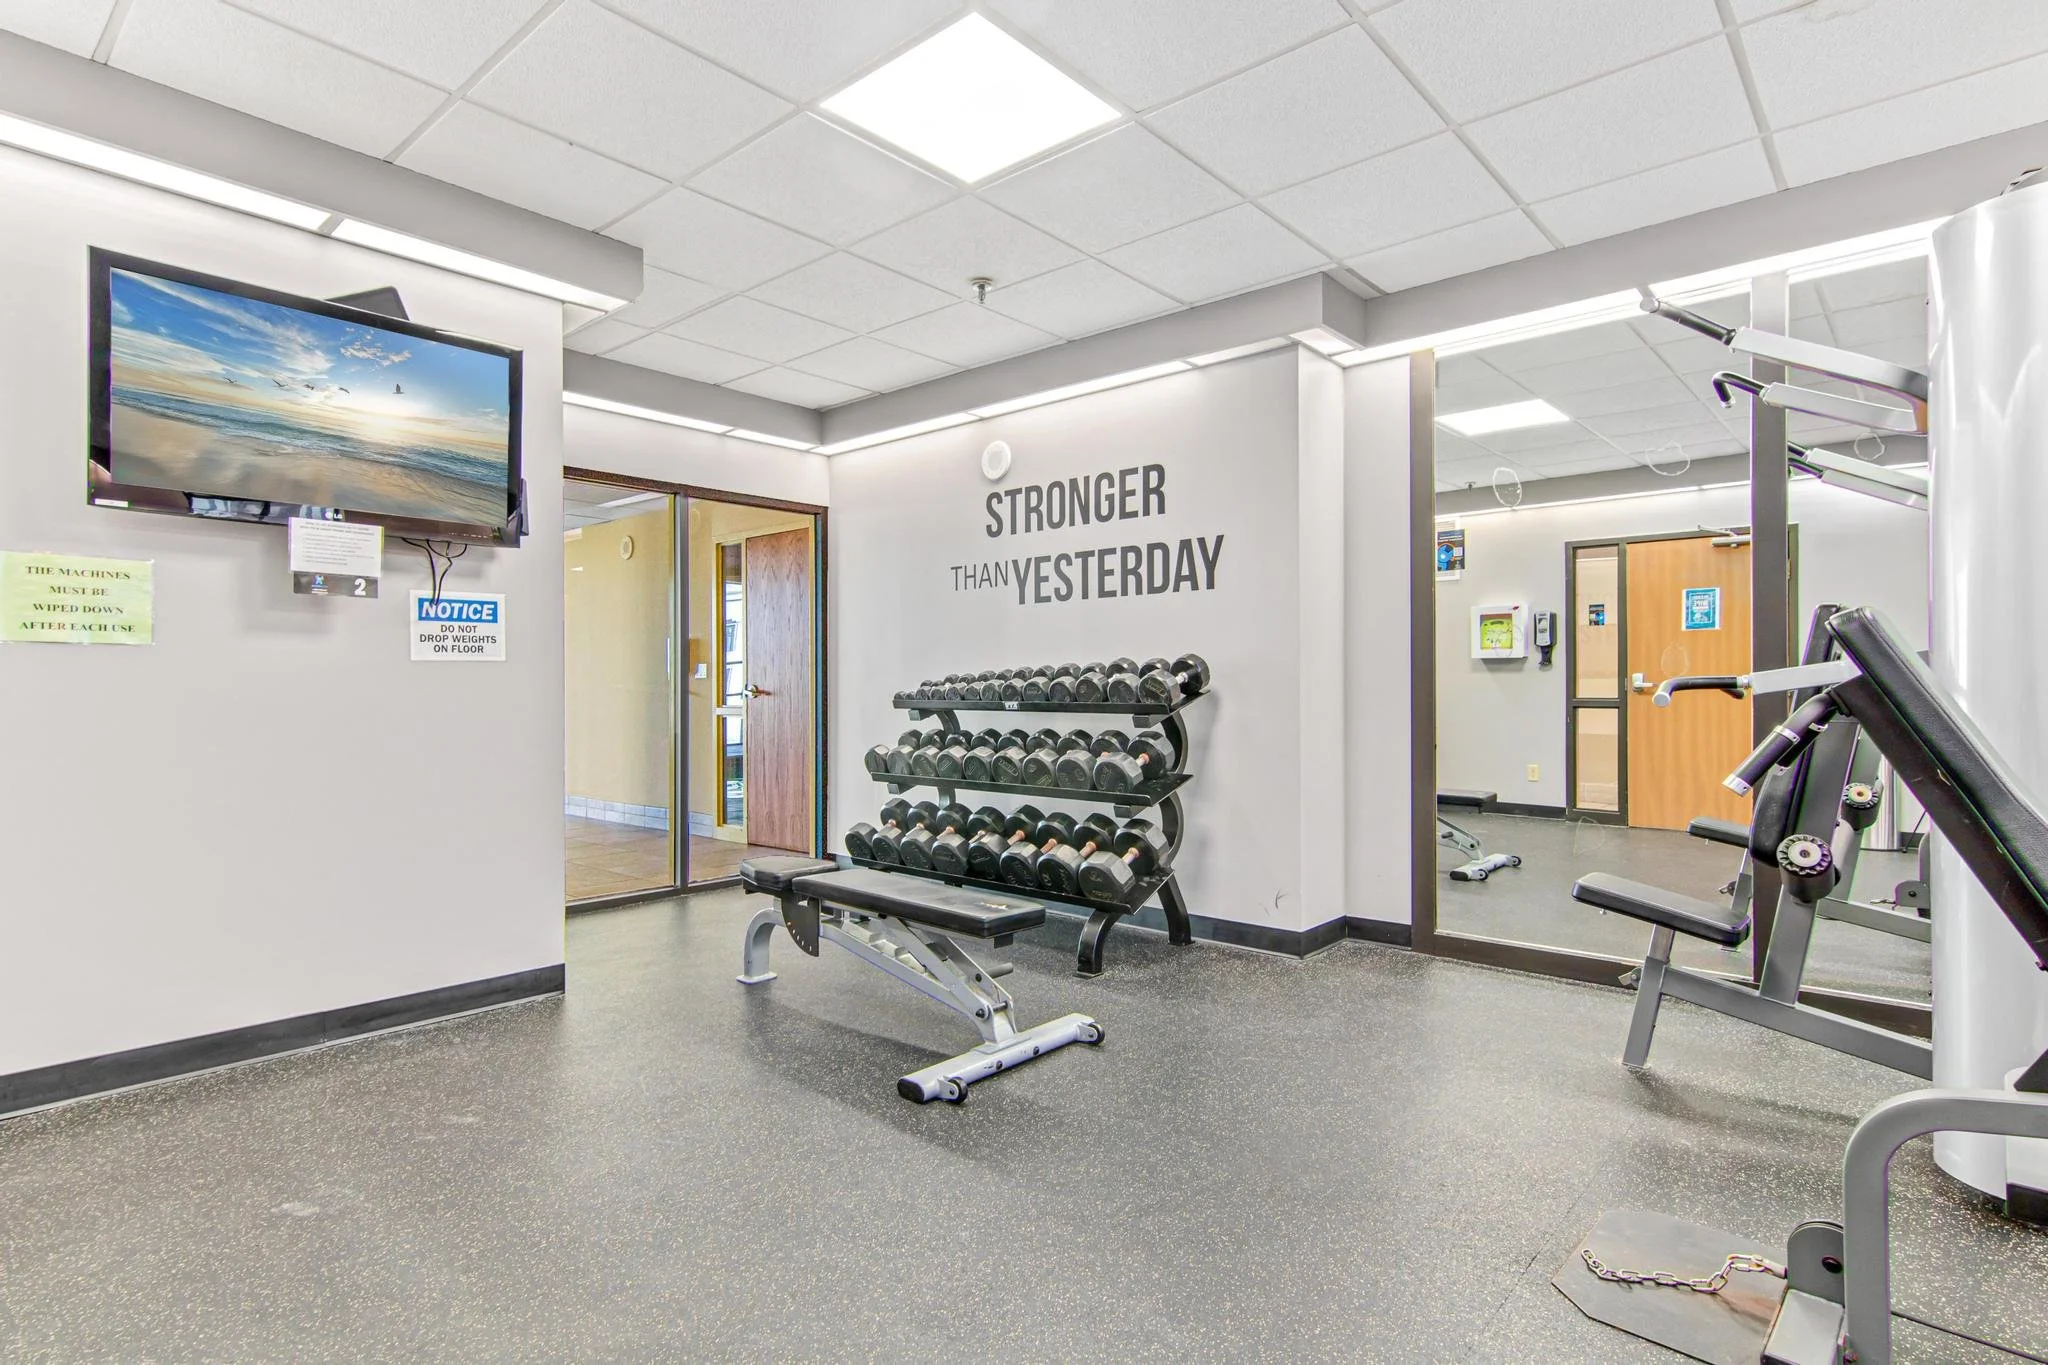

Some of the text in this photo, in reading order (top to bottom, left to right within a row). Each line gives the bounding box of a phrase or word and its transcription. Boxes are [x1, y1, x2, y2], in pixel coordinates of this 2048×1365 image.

[986, 463, 1166, 538] STRONGER
[25, 565, 131, 580] THE MACHINES
[950, 534, 1225, 605] THAN YESTERDAY
[49, 585, 109, 597] MUST BE
[353, 577, 367, 596] 2
[32, 603, 124, 615] WIPED DOWN
[421, 601, 495, 620] NOTICE
[20, 621, 137, 633] AFTER EACH USE
[440, 624, 478, 634] DO NOT
[419, 634, 497, 644] DROP WEIGHTS
[433, 644, 484, 654] ON FLOOR
